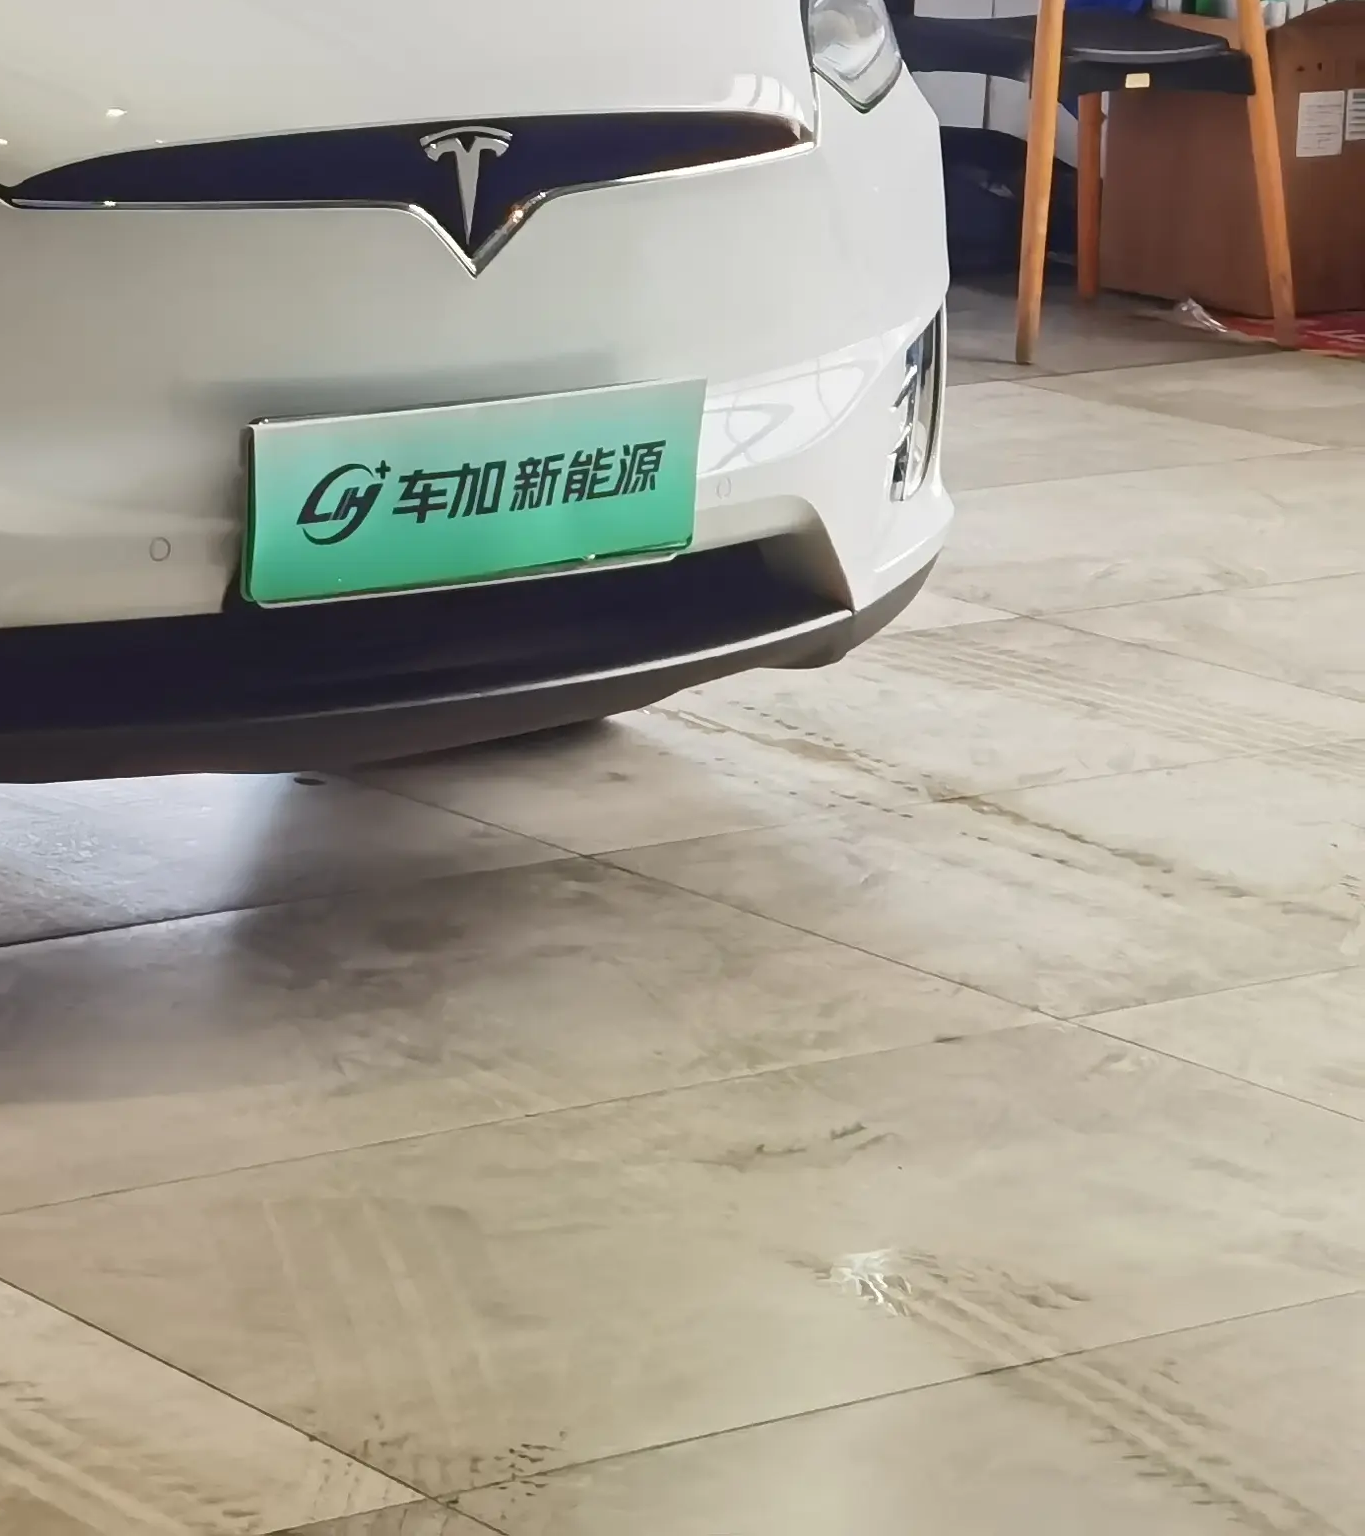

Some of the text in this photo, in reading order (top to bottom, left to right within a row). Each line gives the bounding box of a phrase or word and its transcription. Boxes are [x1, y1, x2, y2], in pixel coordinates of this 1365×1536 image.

[391, 439, 667, 525] 车加新能源
